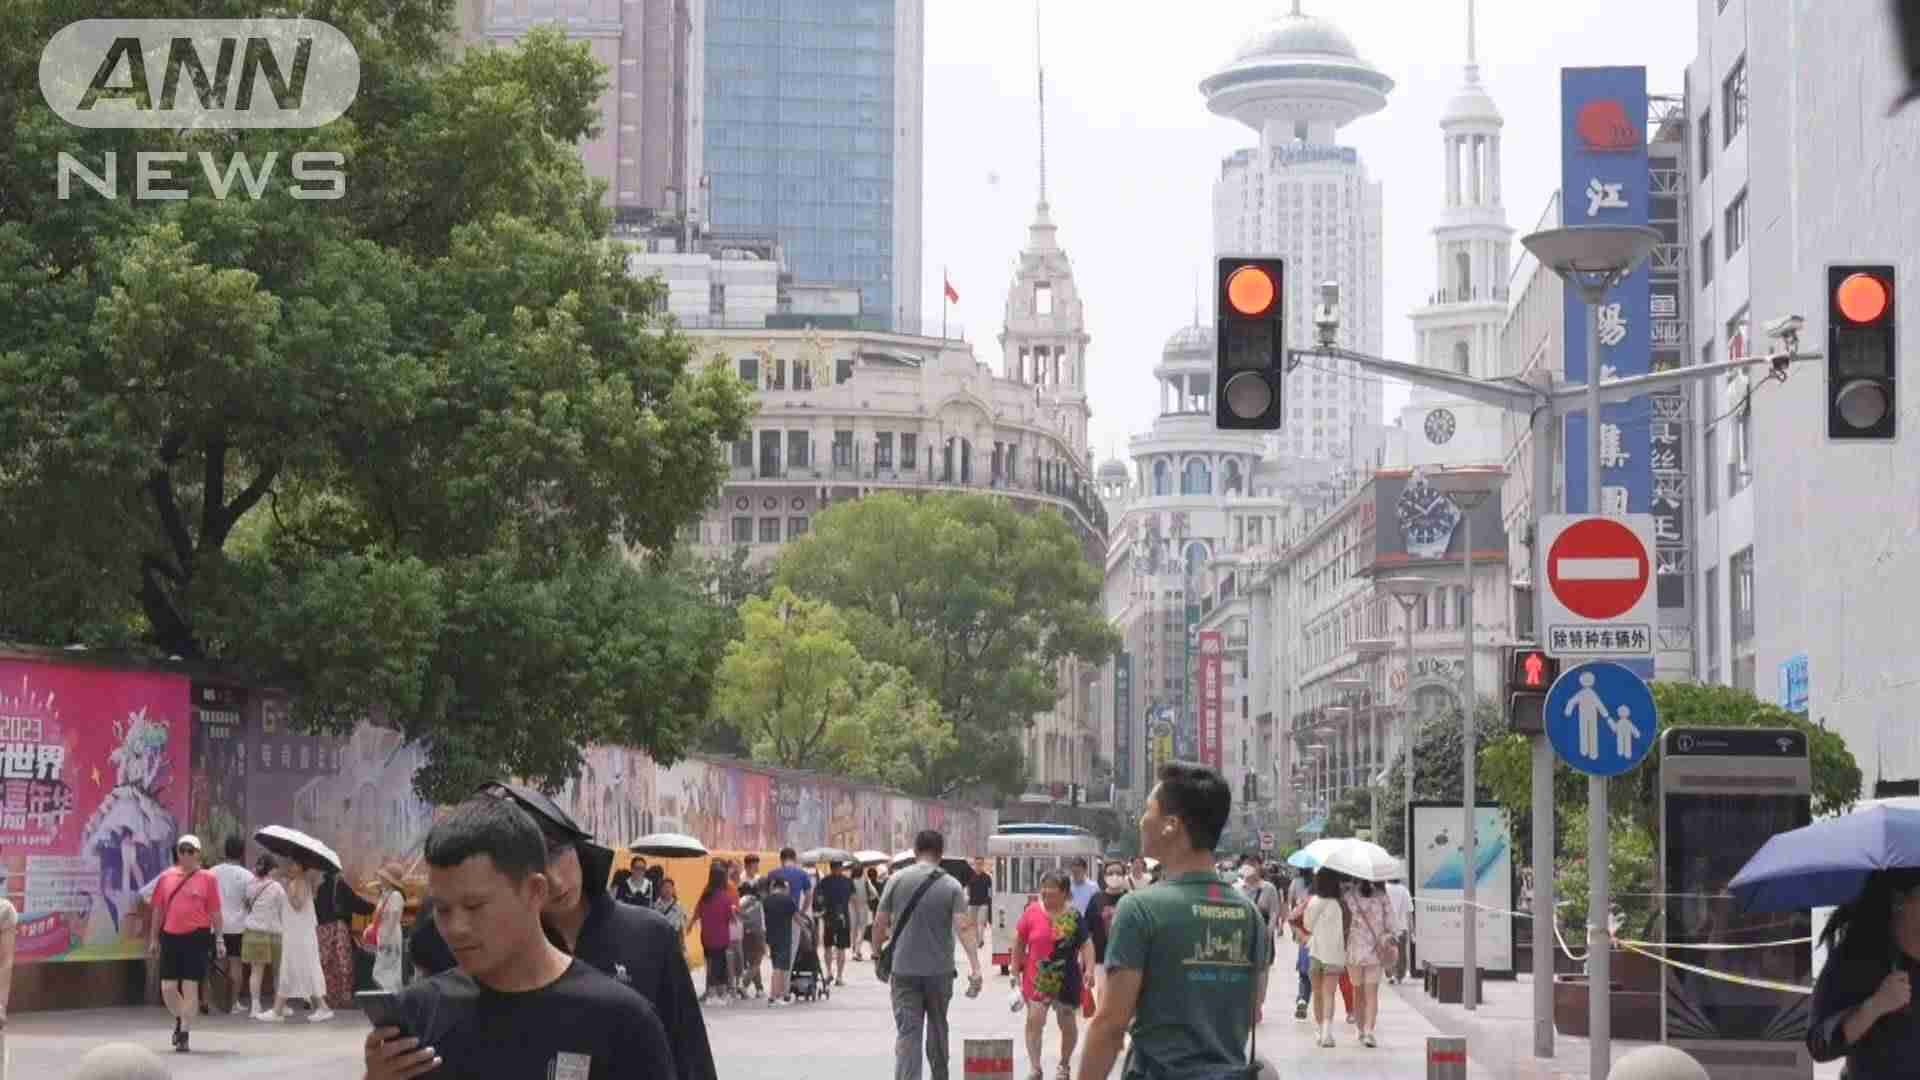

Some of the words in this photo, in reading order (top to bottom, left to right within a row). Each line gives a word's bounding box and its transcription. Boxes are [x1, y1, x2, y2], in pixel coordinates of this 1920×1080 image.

[1553, 629, 1646, 649] 除特种车辆外
[0, 716, 42, 742] 2023
